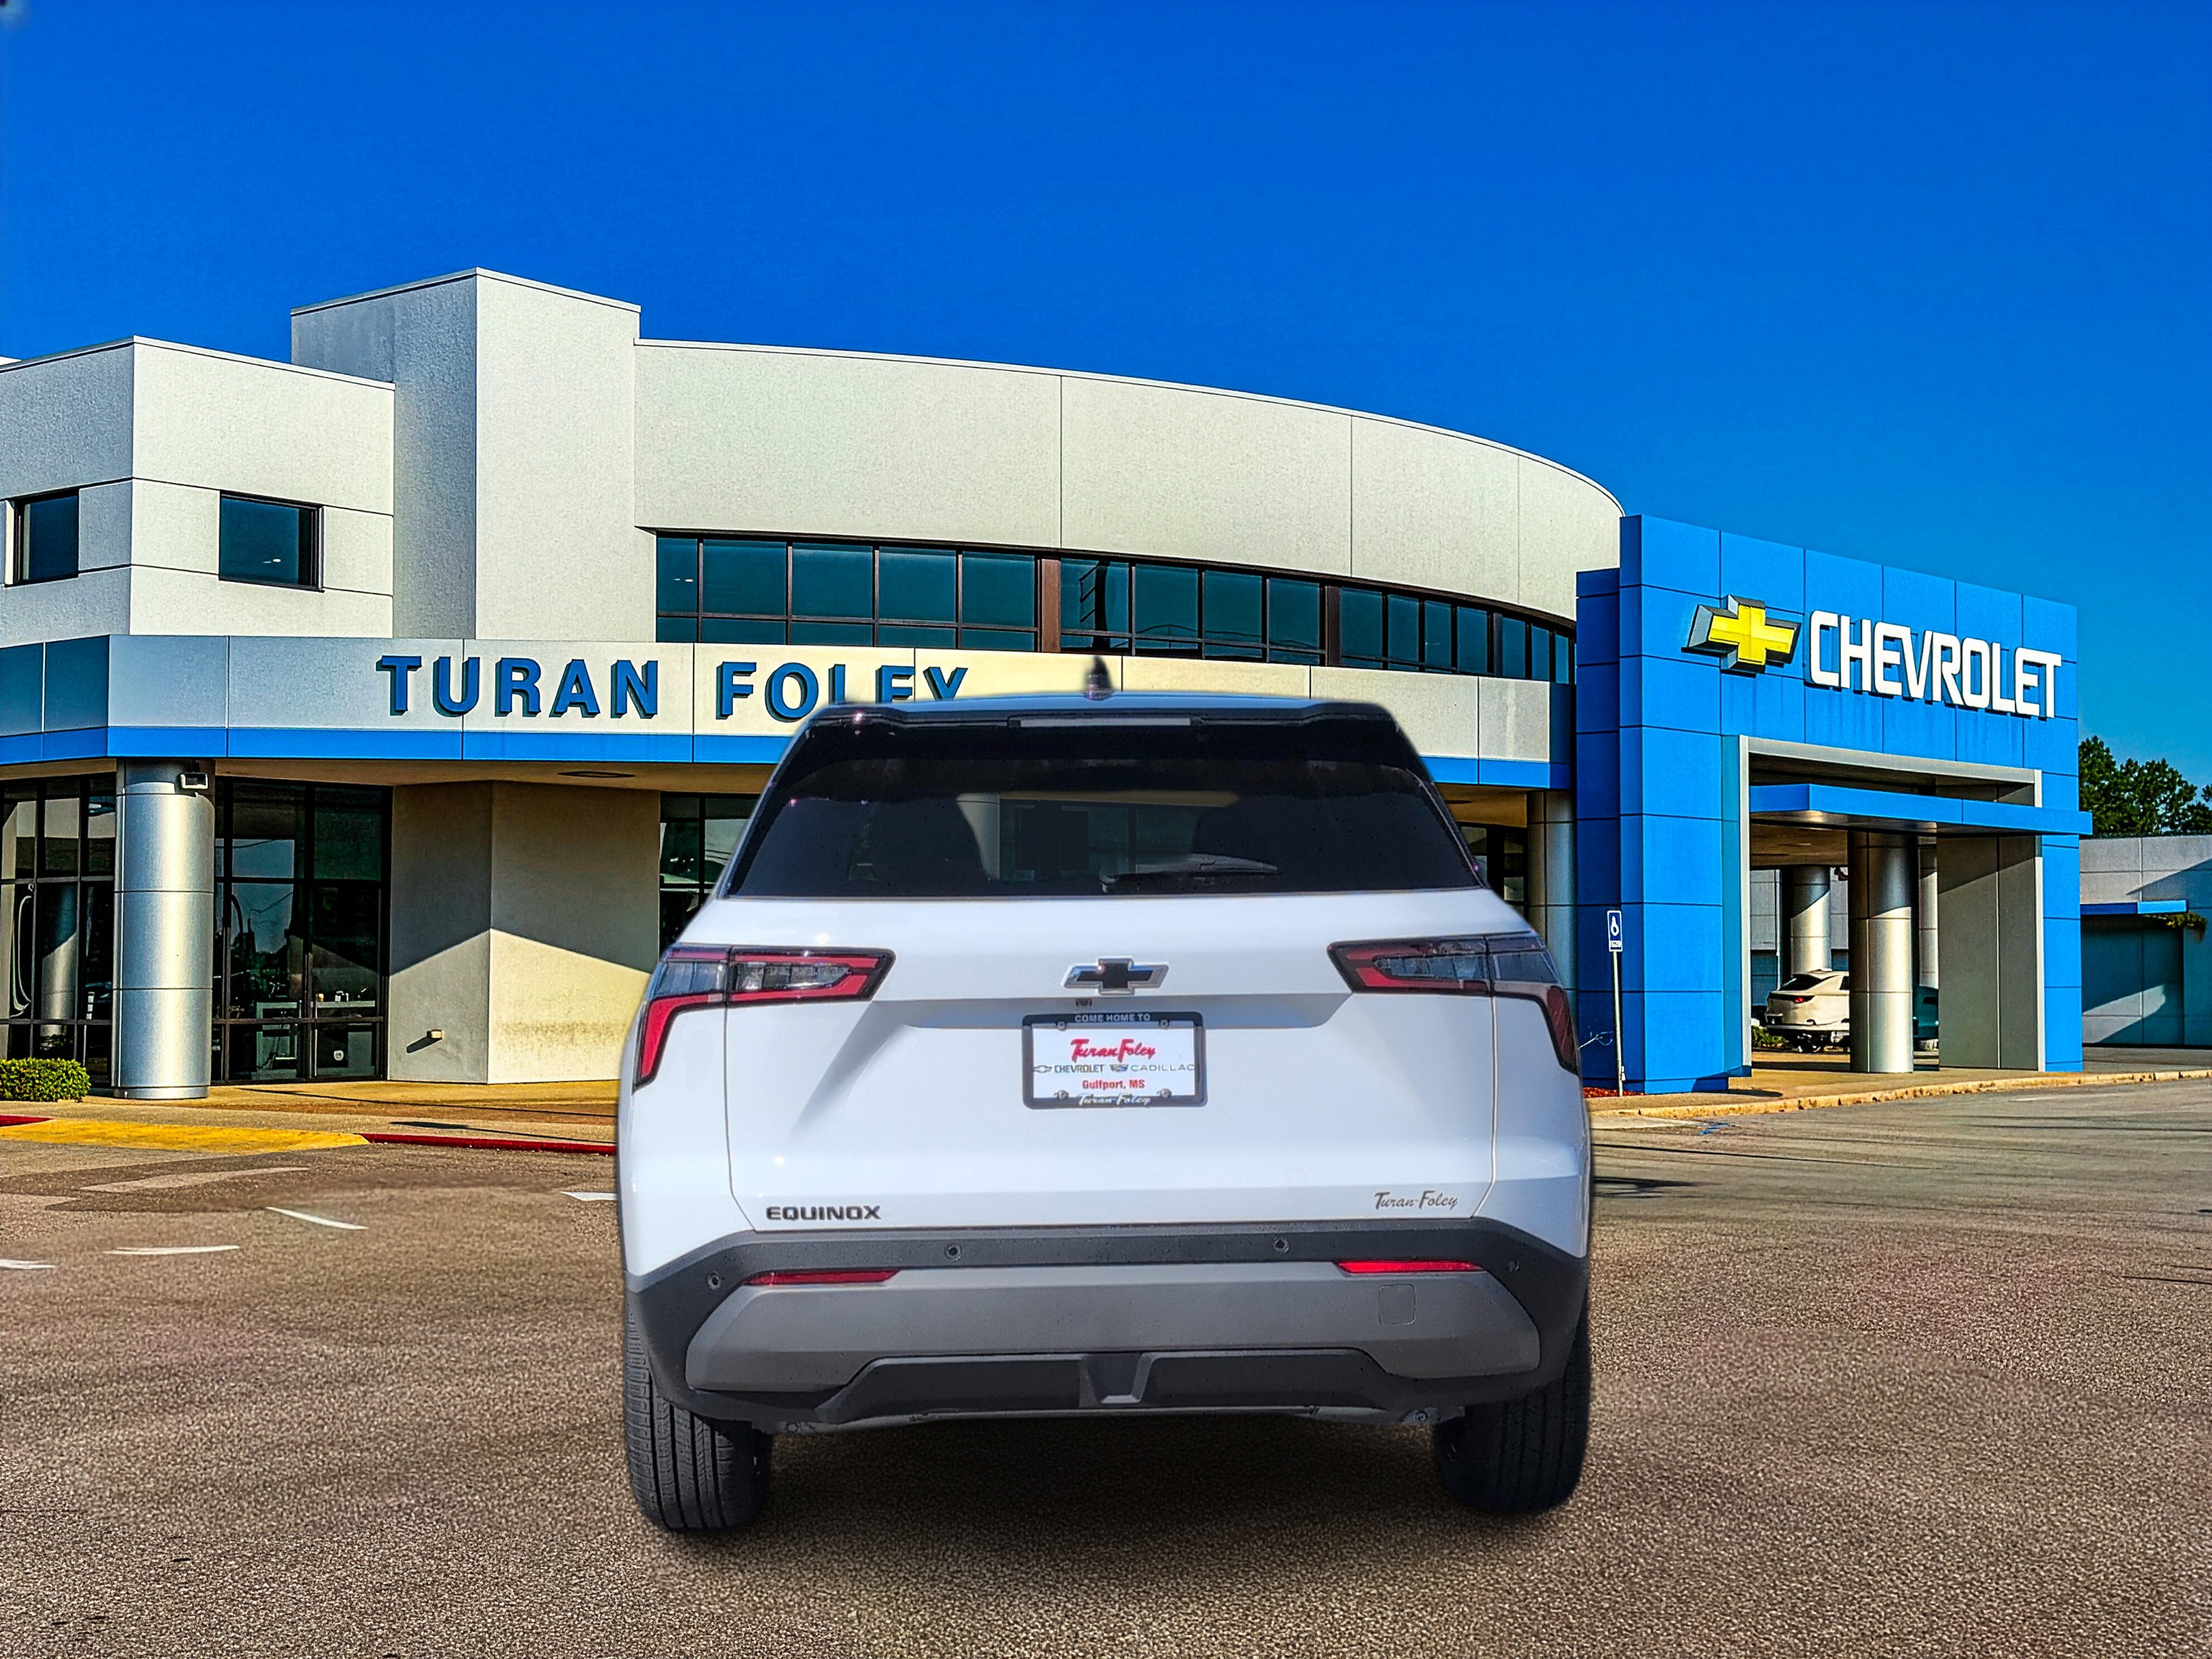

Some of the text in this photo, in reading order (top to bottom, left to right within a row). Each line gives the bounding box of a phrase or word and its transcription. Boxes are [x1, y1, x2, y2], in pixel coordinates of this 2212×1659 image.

[1806, 610, 2062, 719] CHEVROLET
[376, 655, 969, 722] TURAN FOLEY
[1075, 1013, 1150, 1023] COME HOME TO
[1070, 1038, 1156, 1063] Turan Foley
[1054, 1064, 1195, 1073] CHEVROLET CADILLAC
[1082, 1079, 1145, 1091] Gulfport, MS
[1374, 1190, 1458, 1211] Turan Foley
[766, 1205, 882, 1221] EQUINOX
